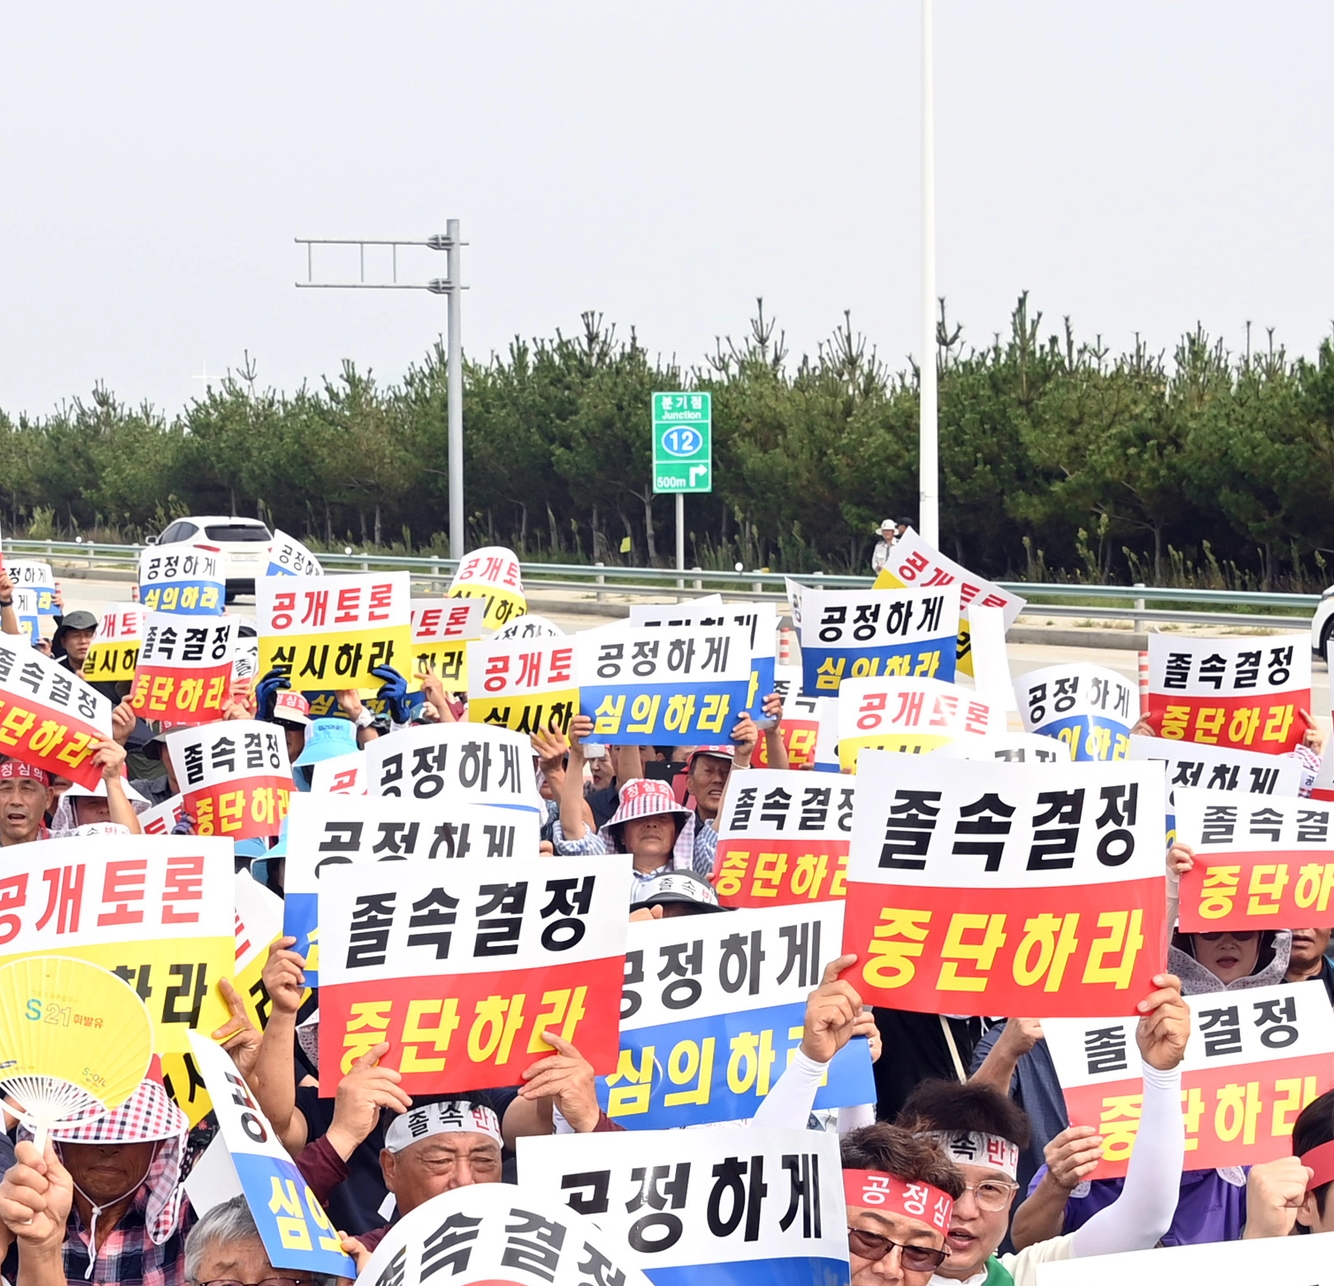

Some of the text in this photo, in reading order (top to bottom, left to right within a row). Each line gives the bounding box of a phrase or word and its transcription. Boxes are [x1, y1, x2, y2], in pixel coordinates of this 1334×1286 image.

[661, 396, 702, 410] 분기점
[661, 411, 701, 420] Junction
[669, 431, 694, 451] 12
[657, 476, 686, 488] 500m
[8, 567, 47, 585] 정하게
[147, 554, 217, 580] 공정하게
[459, 557, 519, 587] 공개토
[99, 611, 138, 638] 개토
[270, 582, 393, 630] 공개토론
[411, 606, 470, 637] 토론
[818, 595, 945, 643] 공정하게
[141, 624, 231, 662] 졸속결정
[596, 636, 731, 679] 공정하게
[417, 650, 464, 680] 하라
[483, 647, 573, 692] 공개토
[1163, 645, 1295, 690] 졸속결정
[131, 673, 226, 713] 중단하라
[274, 691, 307, 712] 정심의
[856, 691, 990, 735] 공개토론
[1028, 675, 1131, 724] 공정하게
[593, 693, 731, 735] 심의하라
[1160, 703, 1295, 746] 중단하라
[184, 732, 281, 786] 졸속결정
[1047, 723, 1131, 761] 의하라
[379, 741, 522, 799] 공정하게
[626, 780, 670, 798] 정심의
[877, 781, 1140, 873] 졸속결정
[658, 876, 715, 903] 졸속반
[345, 874, 596, 970] 졸속결정
[862, 906, 1145, 994] 중단하라
[340, 985, 588, 1079] 중단하라
[1083, 995, 1299, 1075] 졸결정
[407, 1101, 502, 1139] 졸속반
[861, 1175, 952, 1228] 공정심
